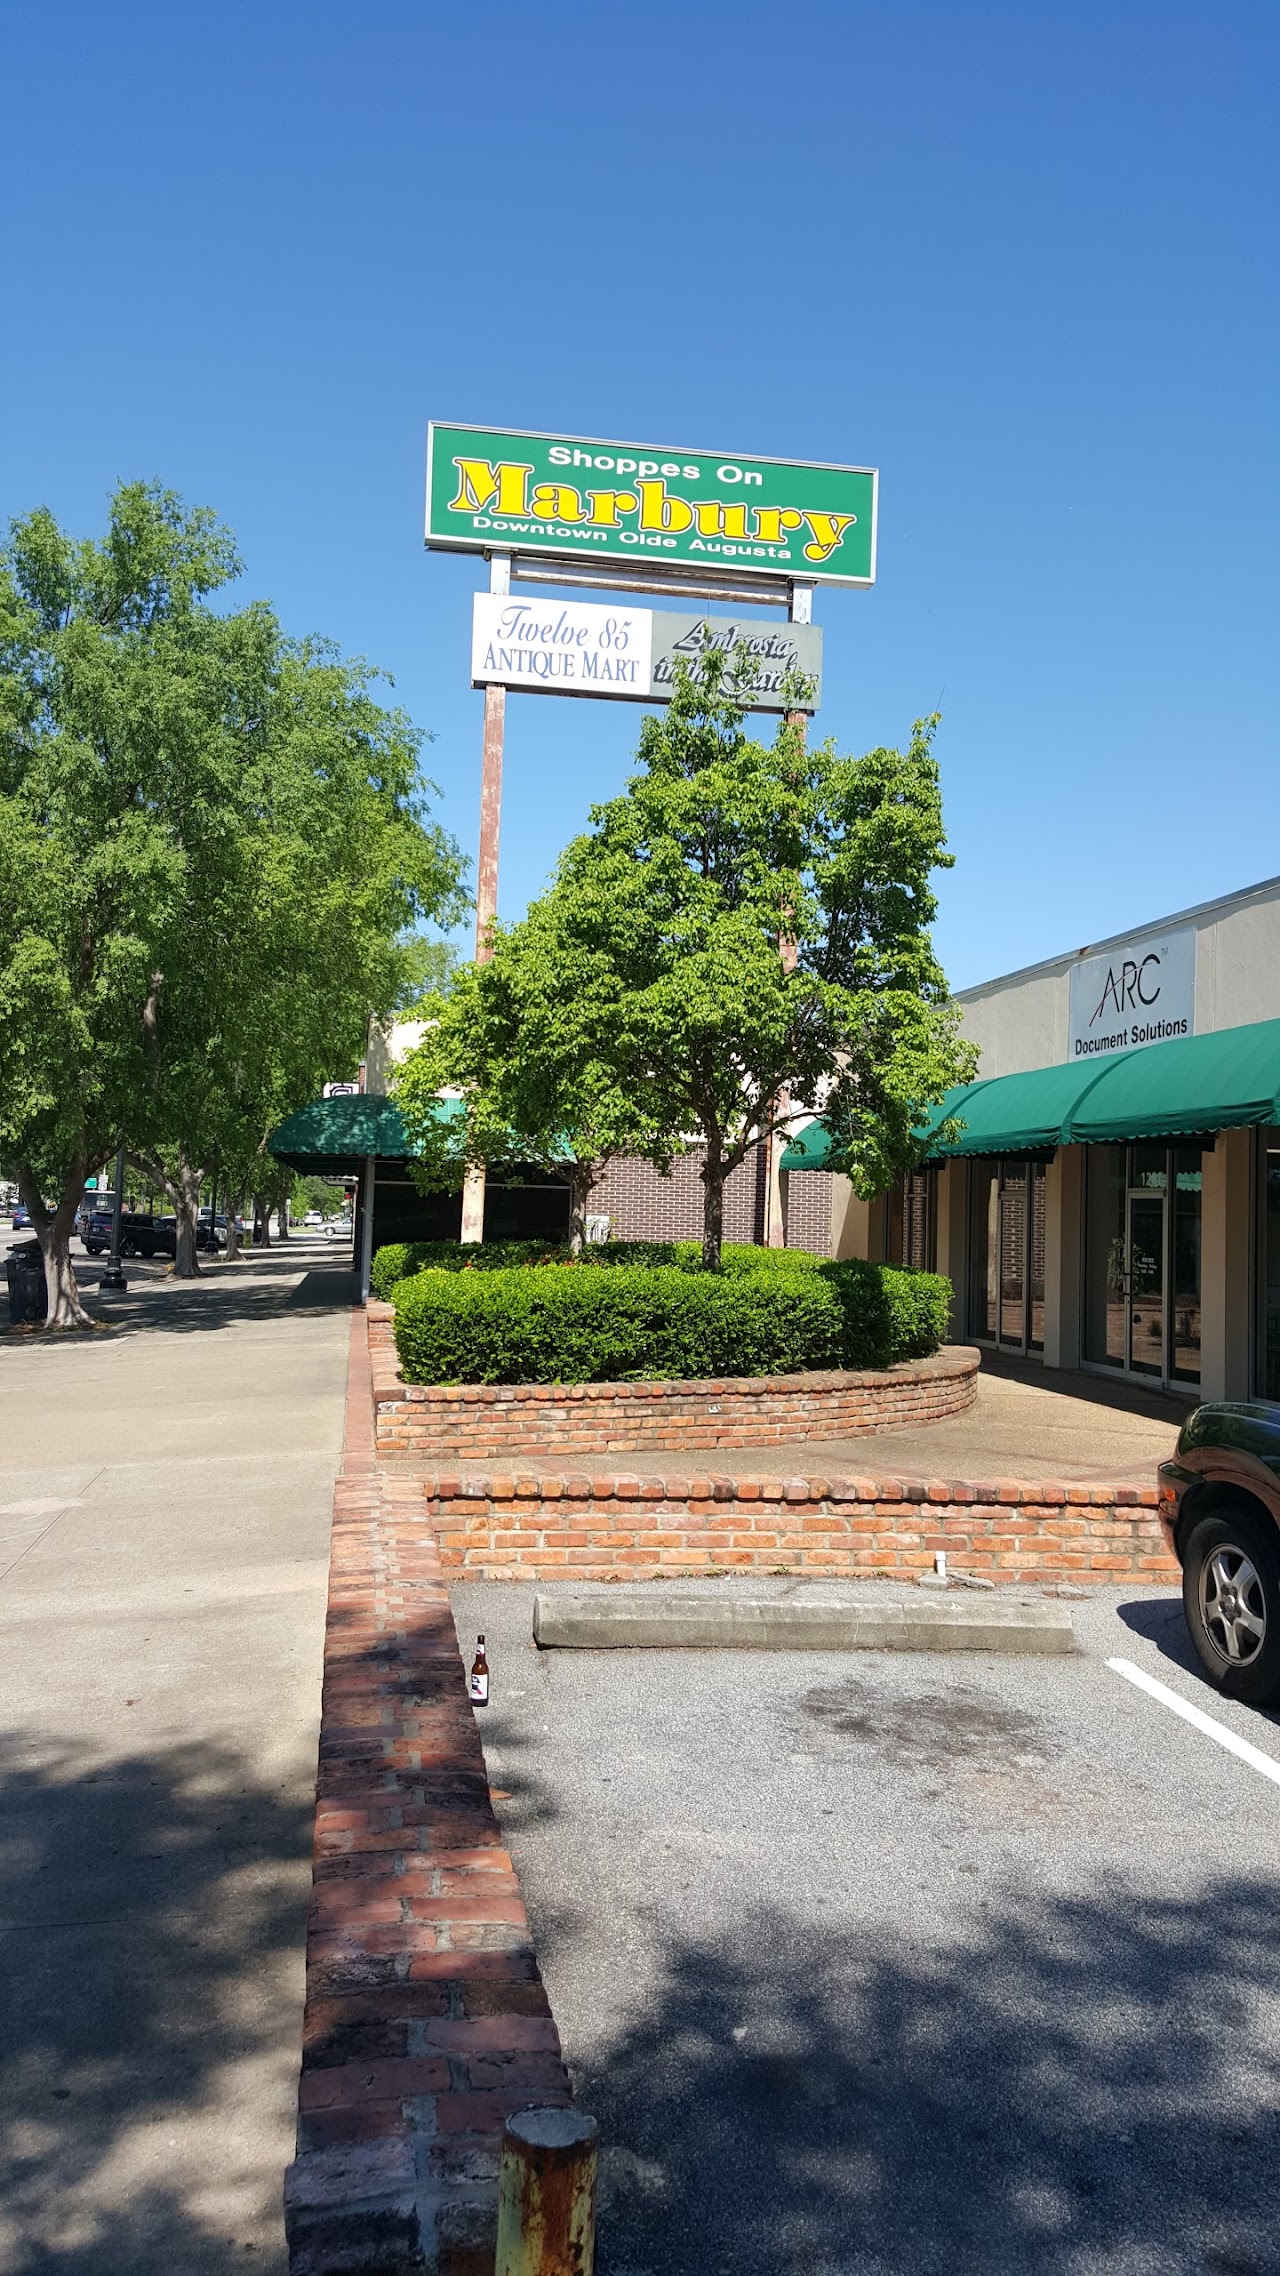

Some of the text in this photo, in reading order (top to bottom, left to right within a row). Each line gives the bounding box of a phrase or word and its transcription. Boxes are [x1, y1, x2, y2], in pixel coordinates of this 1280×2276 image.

[547, 446, 764, 486] Shoppes On
[447, 456, 857, 563] Marbury
[472, 515, 792, 560] Downtown Olde Augusta
[496, 605, 633, 651] Twelve 85
[482, 643, 640, 683] ANTIQUE MART
[718, 652, 819, 698] Gardn
[1095, 953, 1161, 1020] ARC
[1075, 1018, 1188, 1056] Document Solutions
